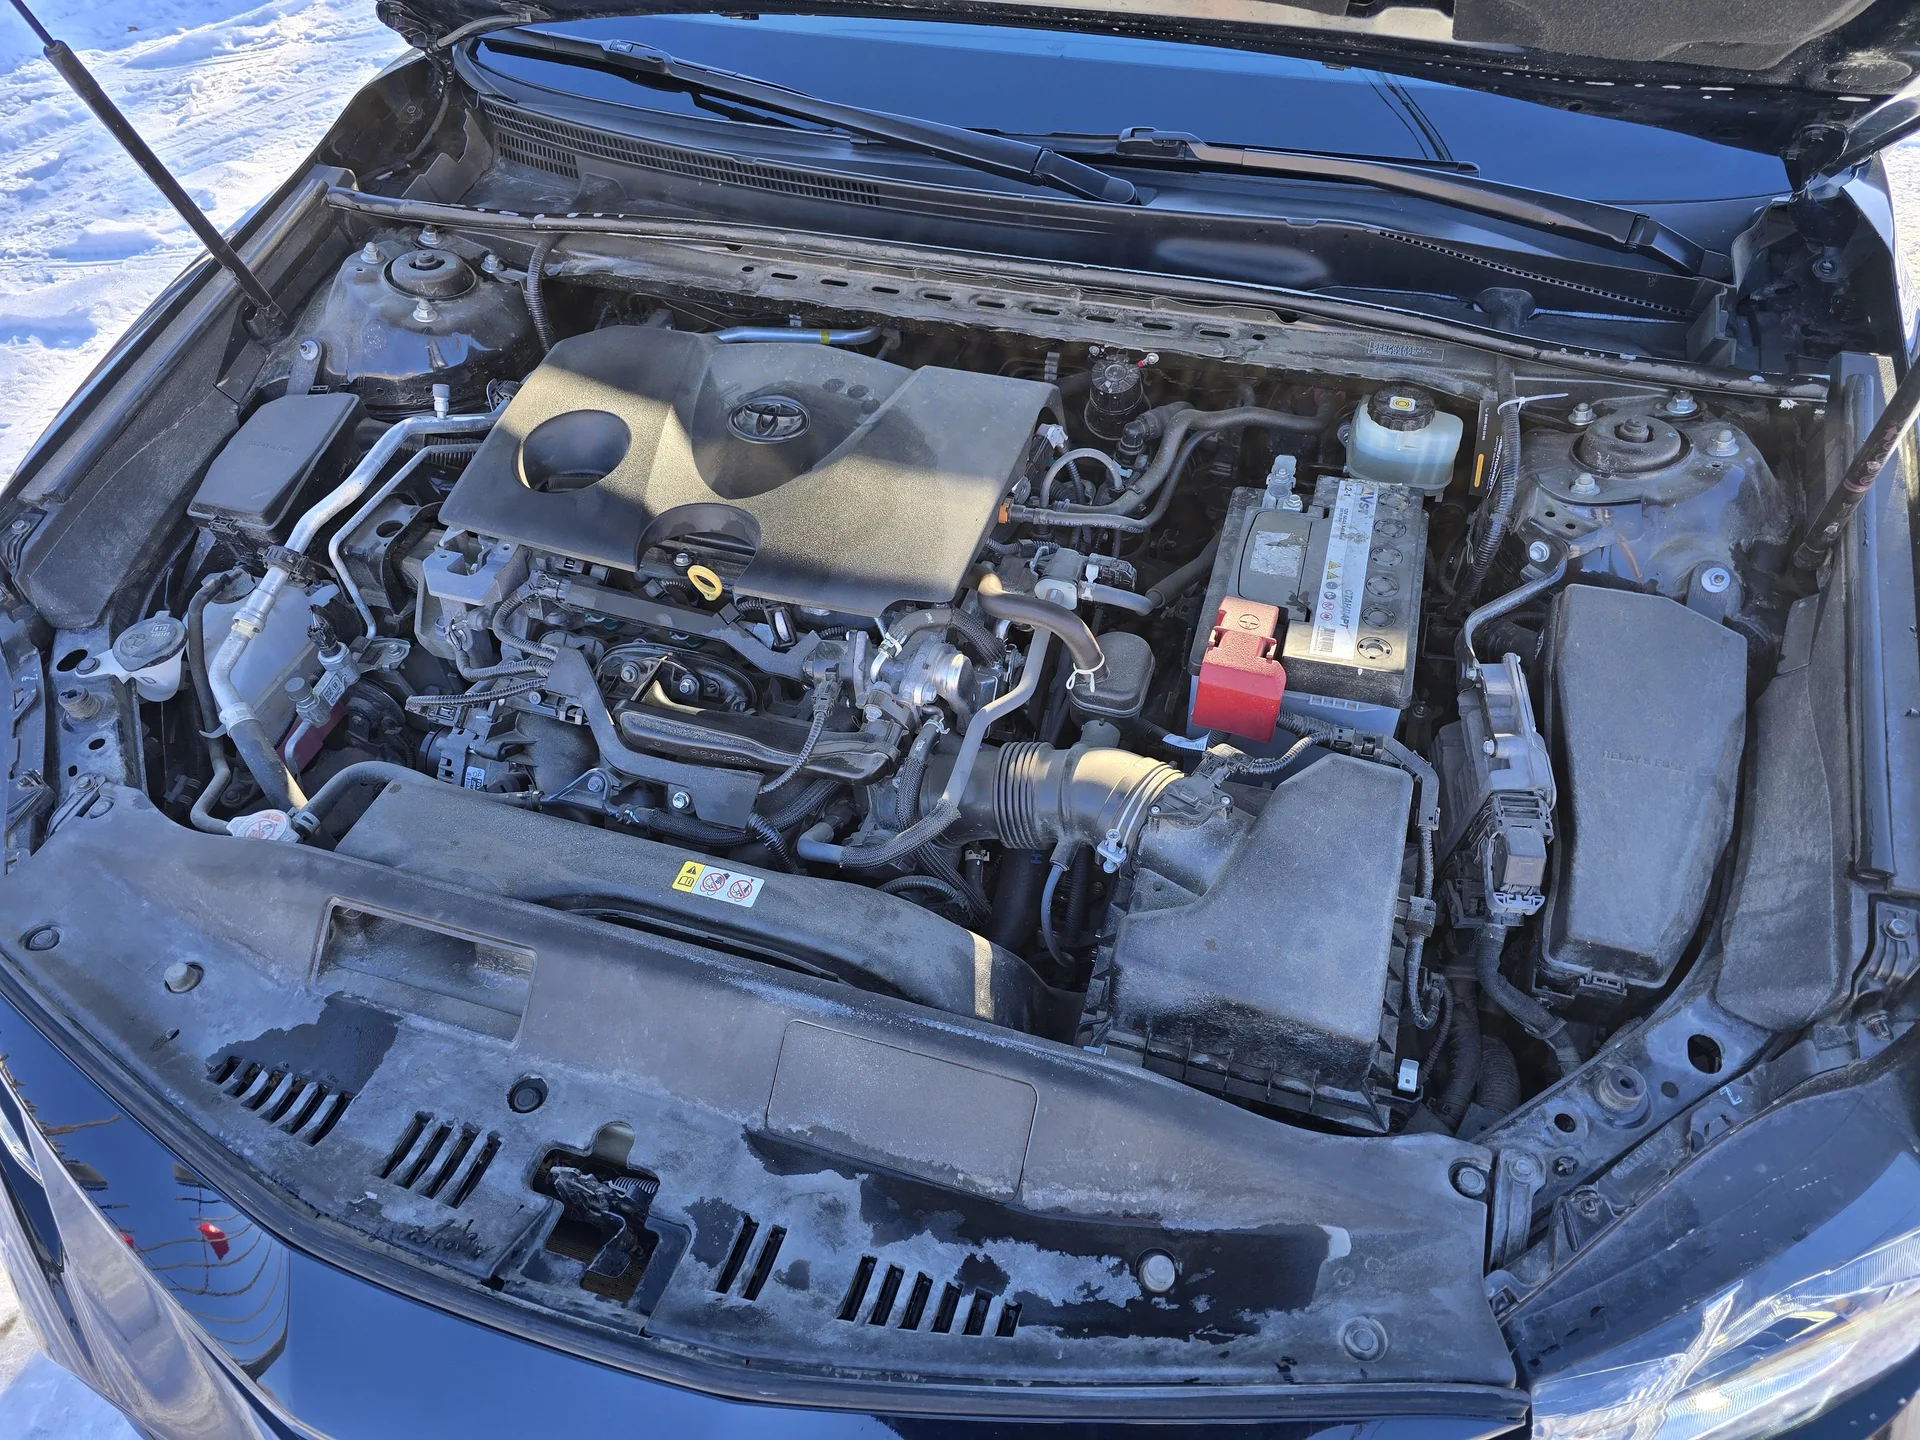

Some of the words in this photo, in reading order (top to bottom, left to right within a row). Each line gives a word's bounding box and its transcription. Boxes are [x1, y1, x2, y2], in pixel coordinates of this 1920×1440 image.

[1340, 589, 1354, 629] СТАНДАРТ
[1602, 749, 1642, 764] RELAY
[1655, 758, 1687, 773] FUSE
